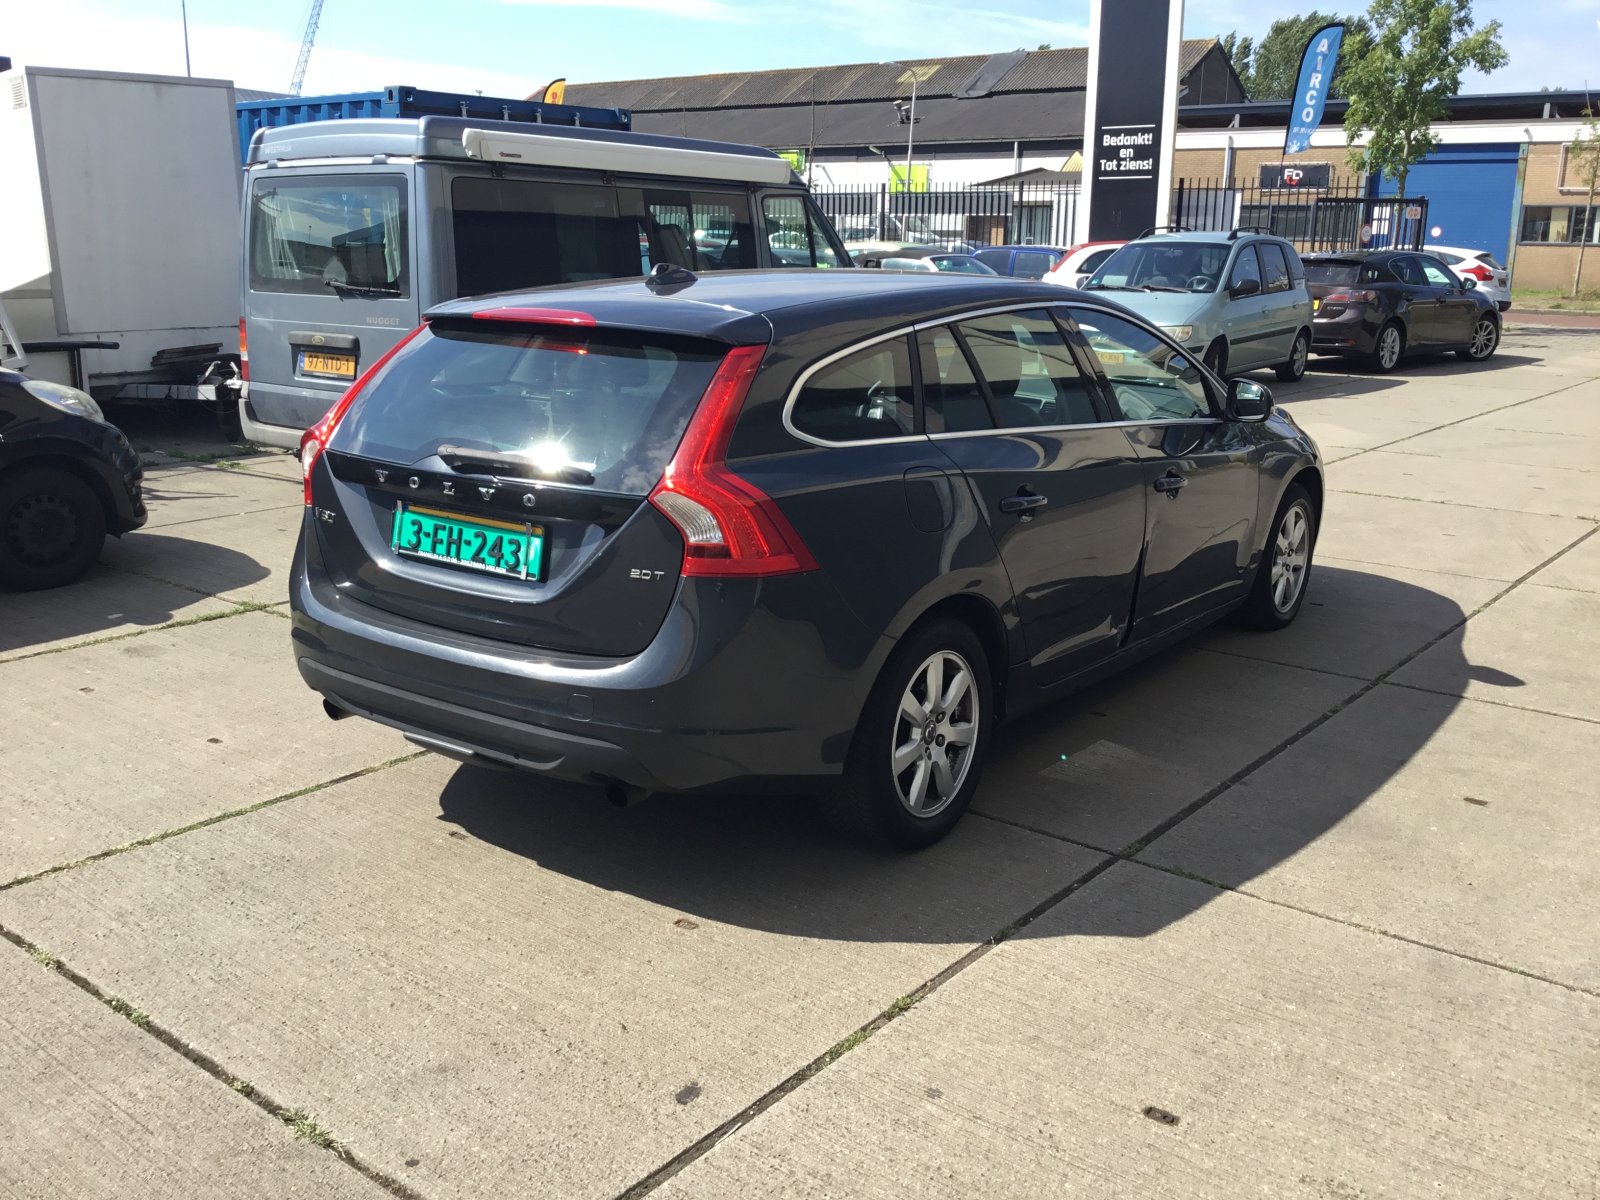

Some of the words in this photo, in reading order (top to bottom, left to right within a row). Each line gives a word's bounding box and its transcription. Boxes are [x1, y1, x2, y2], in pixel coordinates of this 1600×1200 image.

[1302, 38, 1329, 123] AIRCO
[1103, 133, 1153, 146] Bedankt!
[1119, 148, 1134, 158] en
[1100, 160, 1118, 171] Tot
[1120, 158, 1153, 171] ziens!
[366, 316, 400, 326] NUGGET
[308, 354, 350, 372] 97-NTD-1
[375, 469, 536, 508] VOLVO
[407, 519, 522, 570] 3-FH-243
